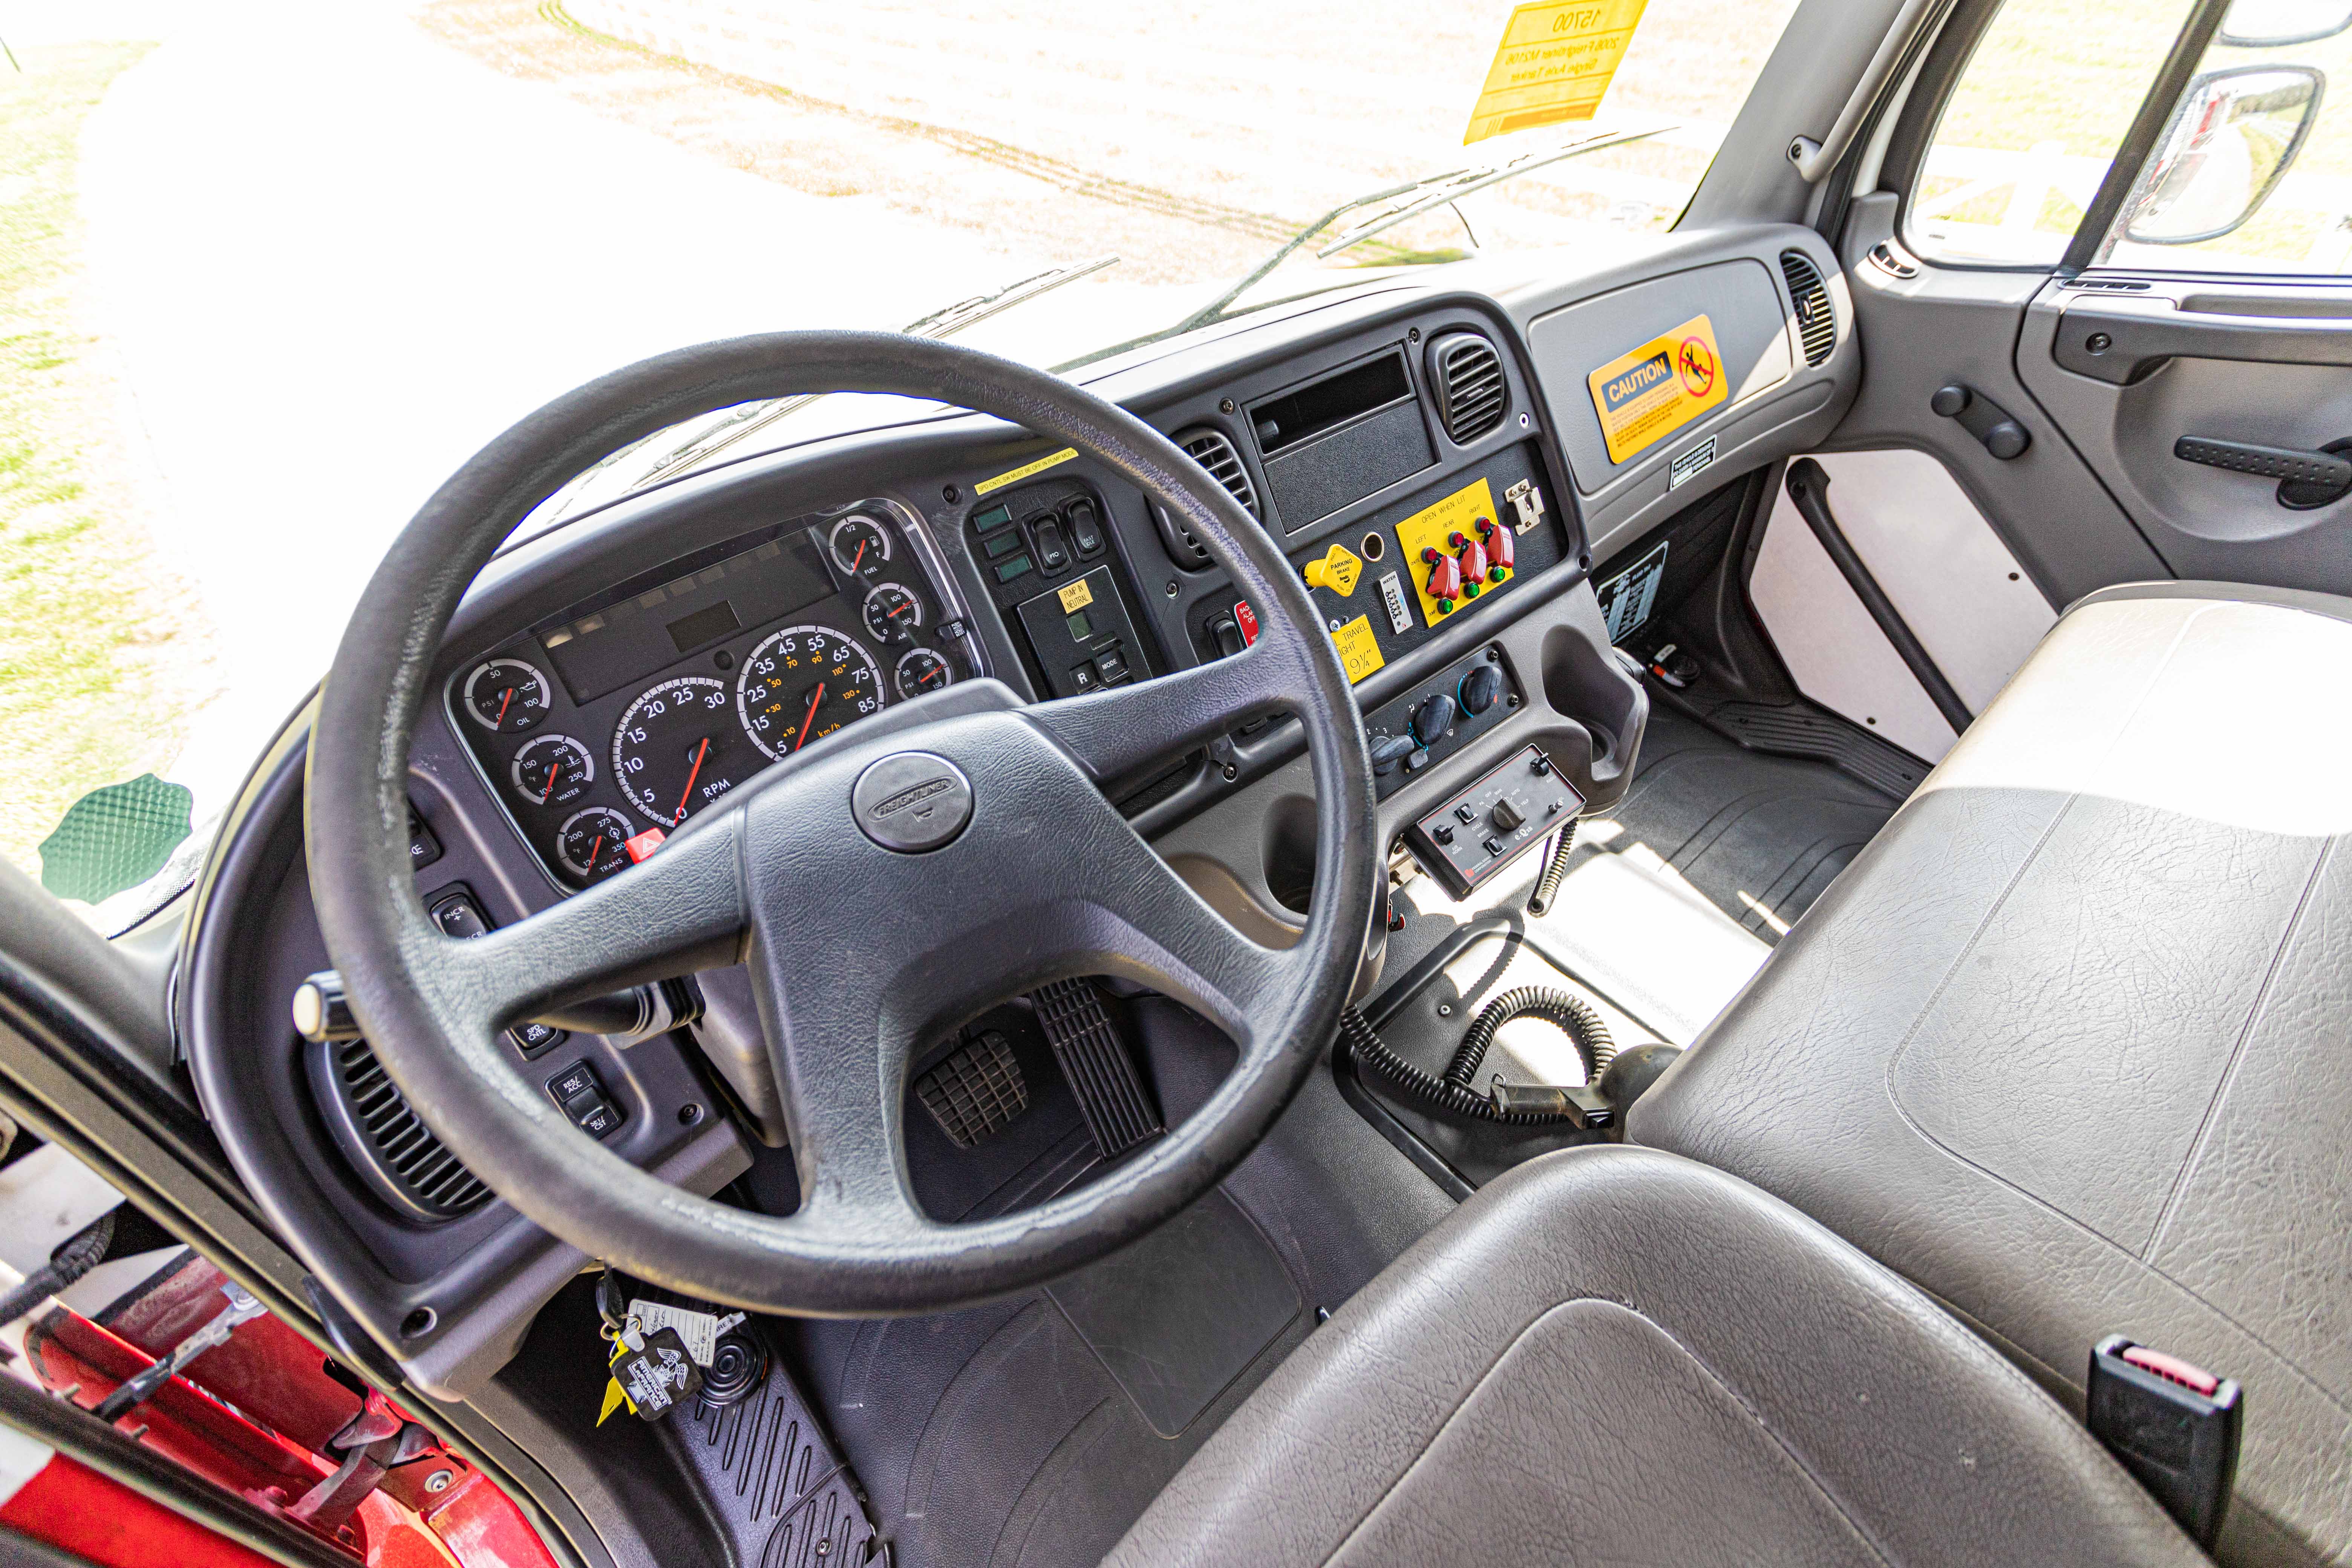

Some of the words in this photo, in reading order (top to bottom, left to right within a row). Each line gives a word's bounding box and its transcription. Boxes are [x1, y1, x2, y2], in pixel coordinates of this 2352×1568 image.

[1608, 357, 1668, 402] CAUTION
[978, 484, 989, 492] SPD
[989, 479, 1002, 488] CNTL
[1011, 470, 1024, 480] MUST
[1032, 462, 1041, 471] OFF
[1047, 455, 1061, 464] PUMP
[1061, 449, 1075, 460] MODE
[1421, 511, 1437, 524] OPEN
[1438, 501, 1455, 515] WHEN
[1456, 494, 1466, 505] LIT
[1469, 504, 1481, 515] RIGHT
[845, 524, 856, 533] 1/2
[1443, 519, 1455, 529] REAR
[1415, 534, 1427, 545] LEFT
[1049, 551, 1059, 560] PTO
[1331, 558, 1353, 570] PARKING
[864, 566, 878, 576] FUEL
[1337, 567, 1351, 575] BRAKE
[1349, 573, 1358, 589] RELEASE
[1382, 575, 1396, 585] WATER
[1064, 586, 1076, 599] PUMP
[1078, 583, 1084, 592] IN
[890, 594, 902, 603] 100
[1066, 594, 1089, 610] NEUTRAL
[870, 604, 879, 612] 50
[901, 617, 912, 626] 150
[898, 632, 907, 641] AIR
[1342, 623, 1369, 642] TRAVEL
[778, 637, 796, 655] 45
[807, 634, 825, 652] 55
[1340, 641, 1356, 657] IGHT
[812, 655, 823, 664] 90
[833, 646, 850, 663] 65
[755, 657, 775, 675] 35
[787, 659, 798, 669] 70
[922, 658, 933, 667] 100
[1102, 658, 1118, 670] MODE
[490, 669, 501, 679] 50
[832, 666, 844, 676] 110
[851, 667, 870, 684] 75
[771, 678, 782, 688] 50
[1077, 672, 1089, 684] R
[932, 681, 943, 690] 150
[672, 687, 694, 706] 25
[747, 684, 767, 703] 25
[842, 690, 856, 700] 130
[481, 700, 495, 709] PSI
[524, 697, 539, 709] 100
[704, 692, 725, 709] 30
[858, 697, 876, 714] 85
[643, 700, 666, 719] 20
[770, 703, 781, 713] 30
[517, 717, 530, 726] OIL
[752, 715, 770, 731] 15
[627, 727, 647, 744] 15
[786, 726, 796, 735] 10
[817, 722, 841, 738] km/h
[552, 745, 568, 757] 200
[777, 740, 787, 754] 5
[522, 759, 537, 770] 150
[624, 756, 645, 774] 10
[568, 771, 584, 783] 250
[702, 778, 731, 798] RPM
[1511, 788, 1521, 796] AUTO
[556, 787, 580, 802] WATER
[643, 787, 656, 803] 5
[878, 779, 950, 818] FREIGHTLINER
[1521, 798, 1530, 807] YELP
[675, 807, 688, 819] 0
[597, 817, 611, 828] 275
[1472, 821, 1484, 831] CYCLE
[568, 830, 583, 842] 200
[1477, 828, 1490, 839] BRAKE
[611, 841, 626, 853] 350
[1452, 846, 1463, 856] HORN
[599, 858, 623, 873] TRANS
[444, 906, 465, 920] INCR
[466, 931, 483, 941] ECR
[527, 1024, 541, 1035] SPD
[528, 1028, 547, 1041] CNTL
[563, 1075, 578, 1089] RES/
[568, 1081, 583, 1094] ACC
[594, 1119, 606, 1130] CST
[637, 1360, 668, 1404] AMERICAN
